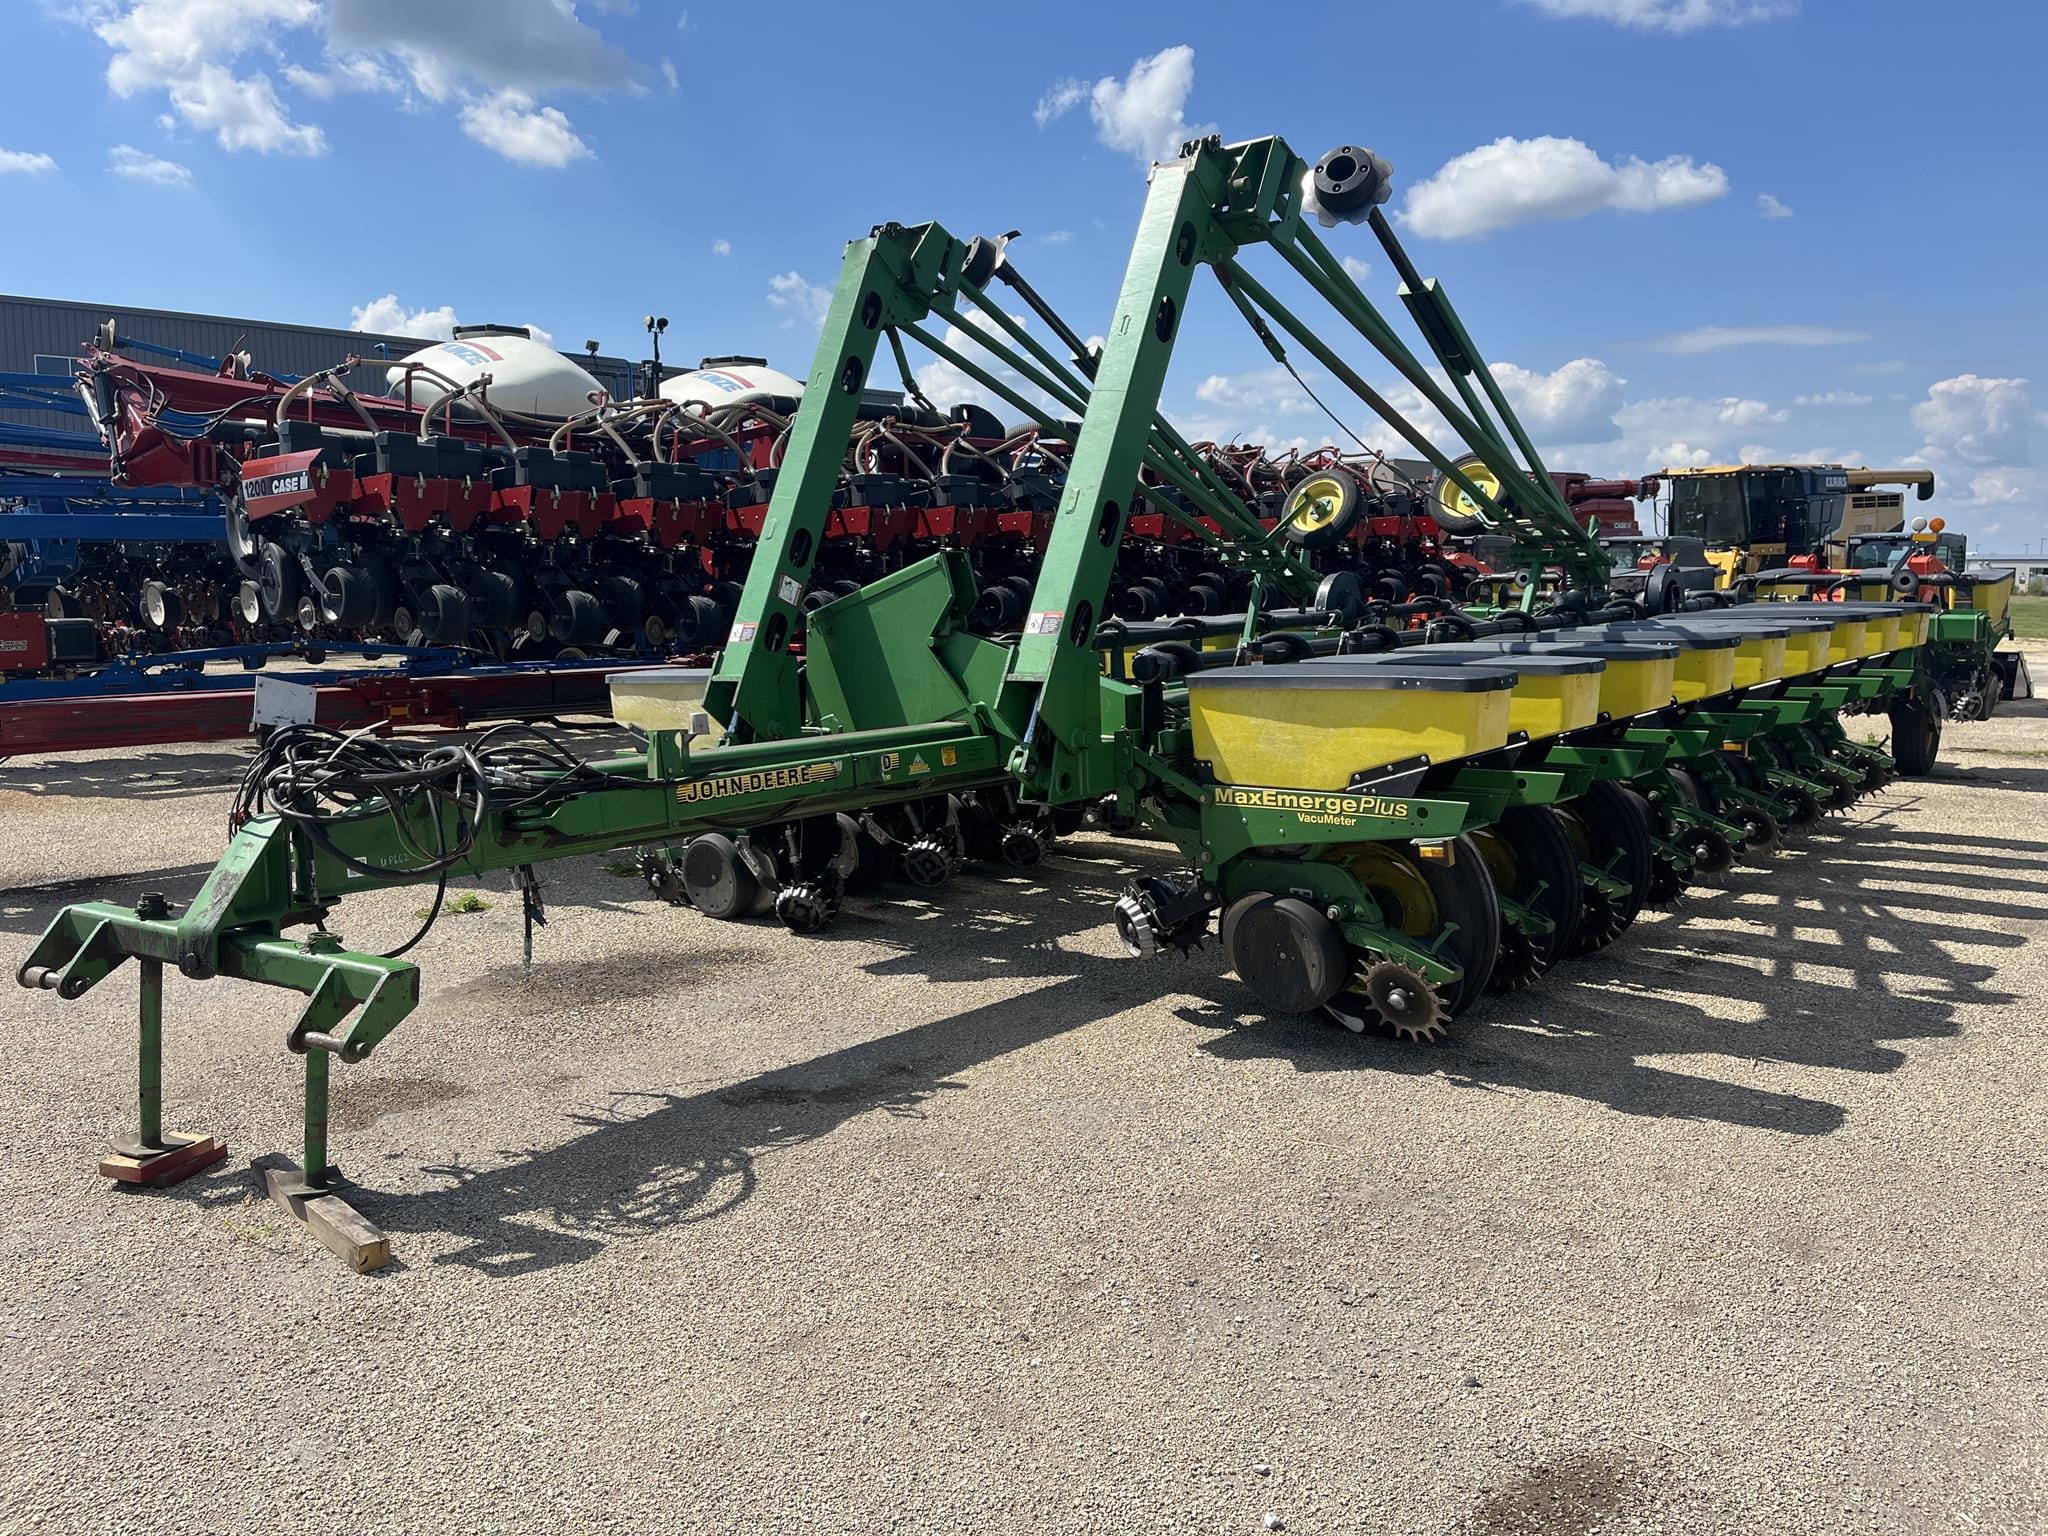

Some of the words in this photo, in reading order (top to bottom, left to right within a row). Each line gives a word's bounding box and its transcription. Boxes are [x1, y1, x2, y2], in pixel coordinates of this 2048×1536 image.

[245, 480, 266, 498] 1200
[272, 477, 298, 494] CASE
[687, 776, 744, 802] JOHN
[749, 766, 811, 791] DEERE
[1297, 812, 1357, 827] VacuMeter
